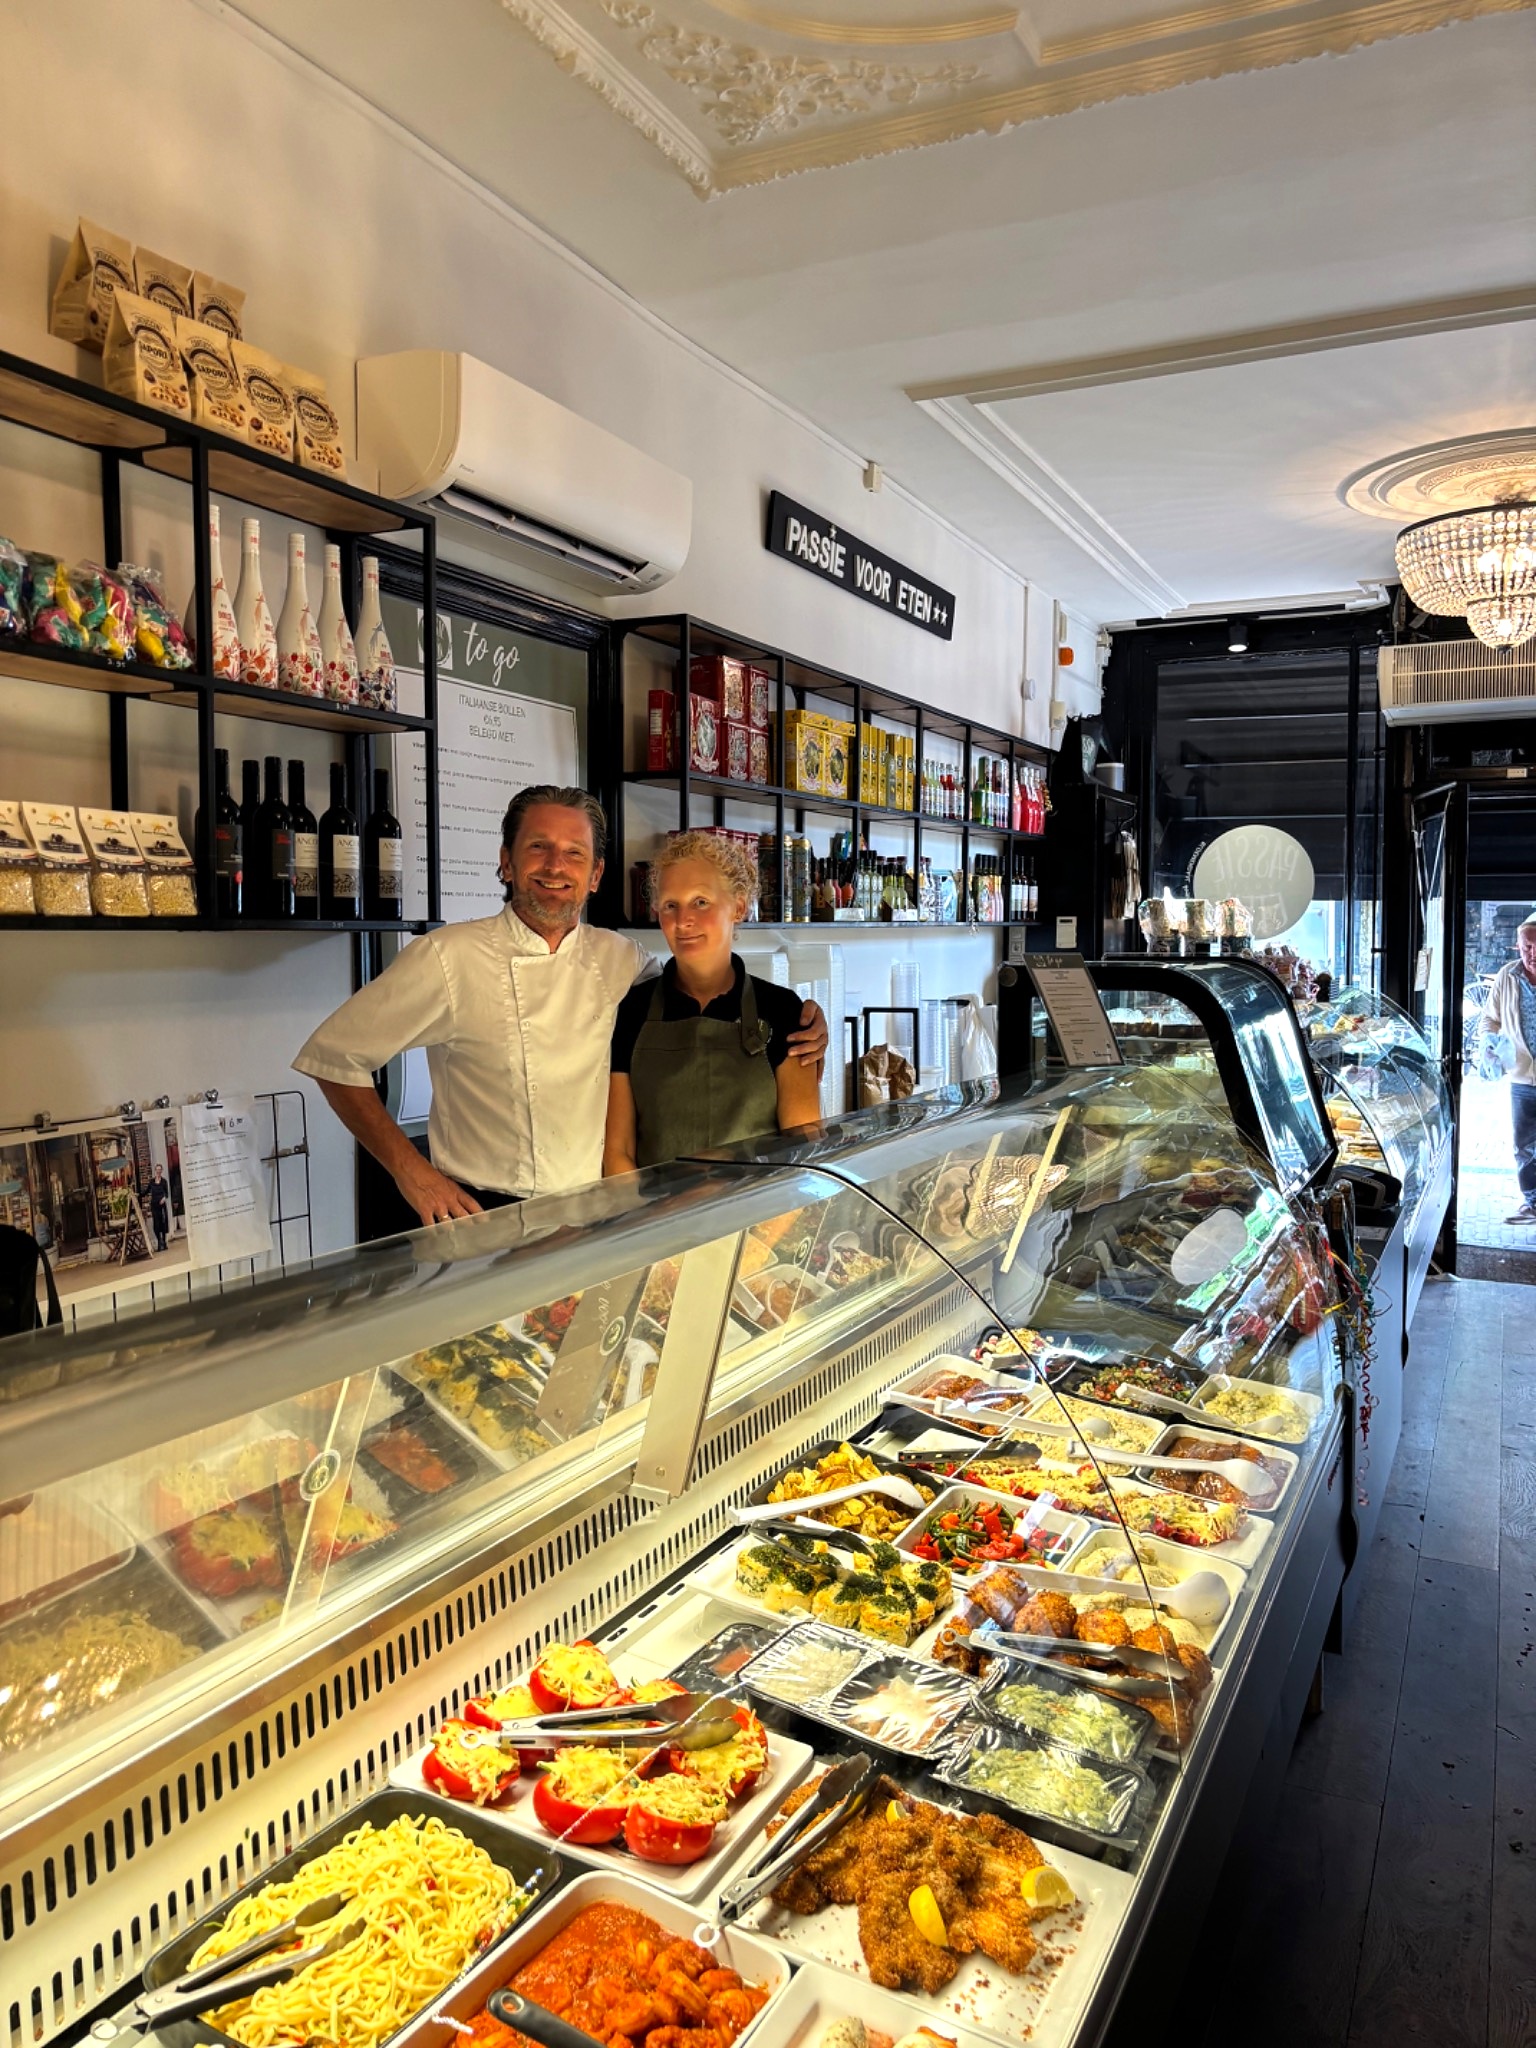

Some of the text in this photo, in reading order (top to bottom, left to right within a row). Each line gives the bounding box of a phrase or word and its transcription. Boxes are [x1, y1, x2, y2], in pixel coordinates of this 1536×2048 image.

[785, 517, 933, 623] PASSIE VOOR ETEN
[463, 622, 489, 667] to
[492, 645, 521, 687] go
[498, 702, 526, 718] BOLLEN
